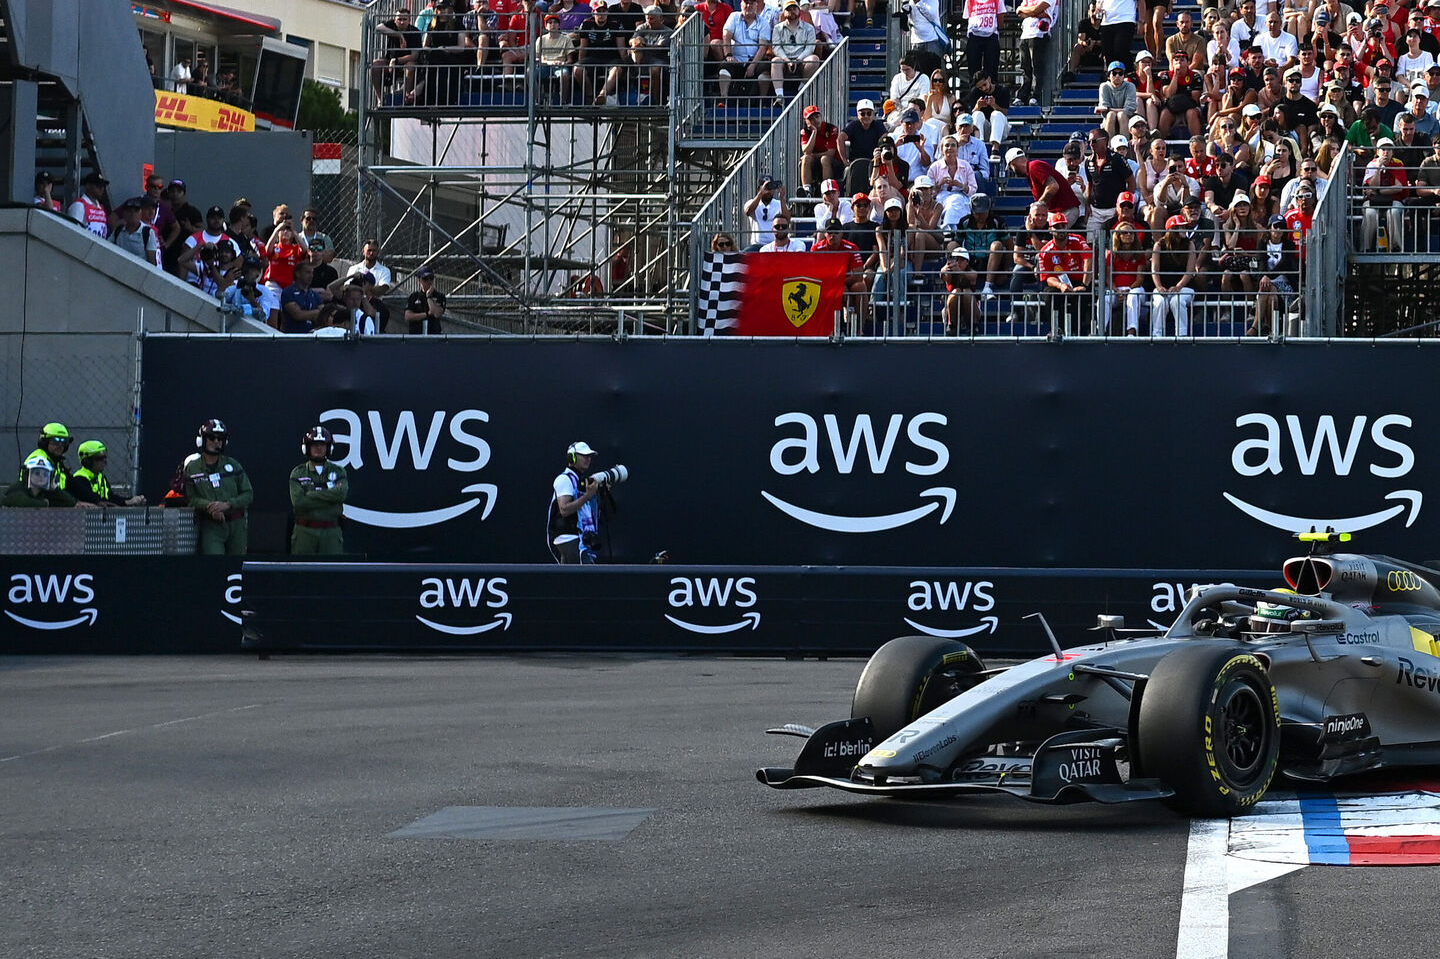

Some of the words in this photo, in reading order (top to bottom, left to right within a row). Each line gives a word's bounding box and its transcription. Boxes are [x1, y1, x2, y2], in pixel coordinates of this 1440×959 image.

[217, 108, 247, 131] DHL
[770, 413, 949, 475] aws
[1232, 413, 1414, 477] aws
[9, 575, 94, 603] aws
[420, 578, 508, 608] aws
[669, 578, 757, 607] aws
[908, 581, 995, 611] aws
[1260, 608, 1282, 618] Revolut
[1316, 622, 1345, 633] Revolut
[1347, 631, 1380, 645] Castrol
[1327, 716, 1364, 735] ninjaOne
[1204, 715, 1221, 782] ZERO
[1059, 759, 1101, 783] QATAR
